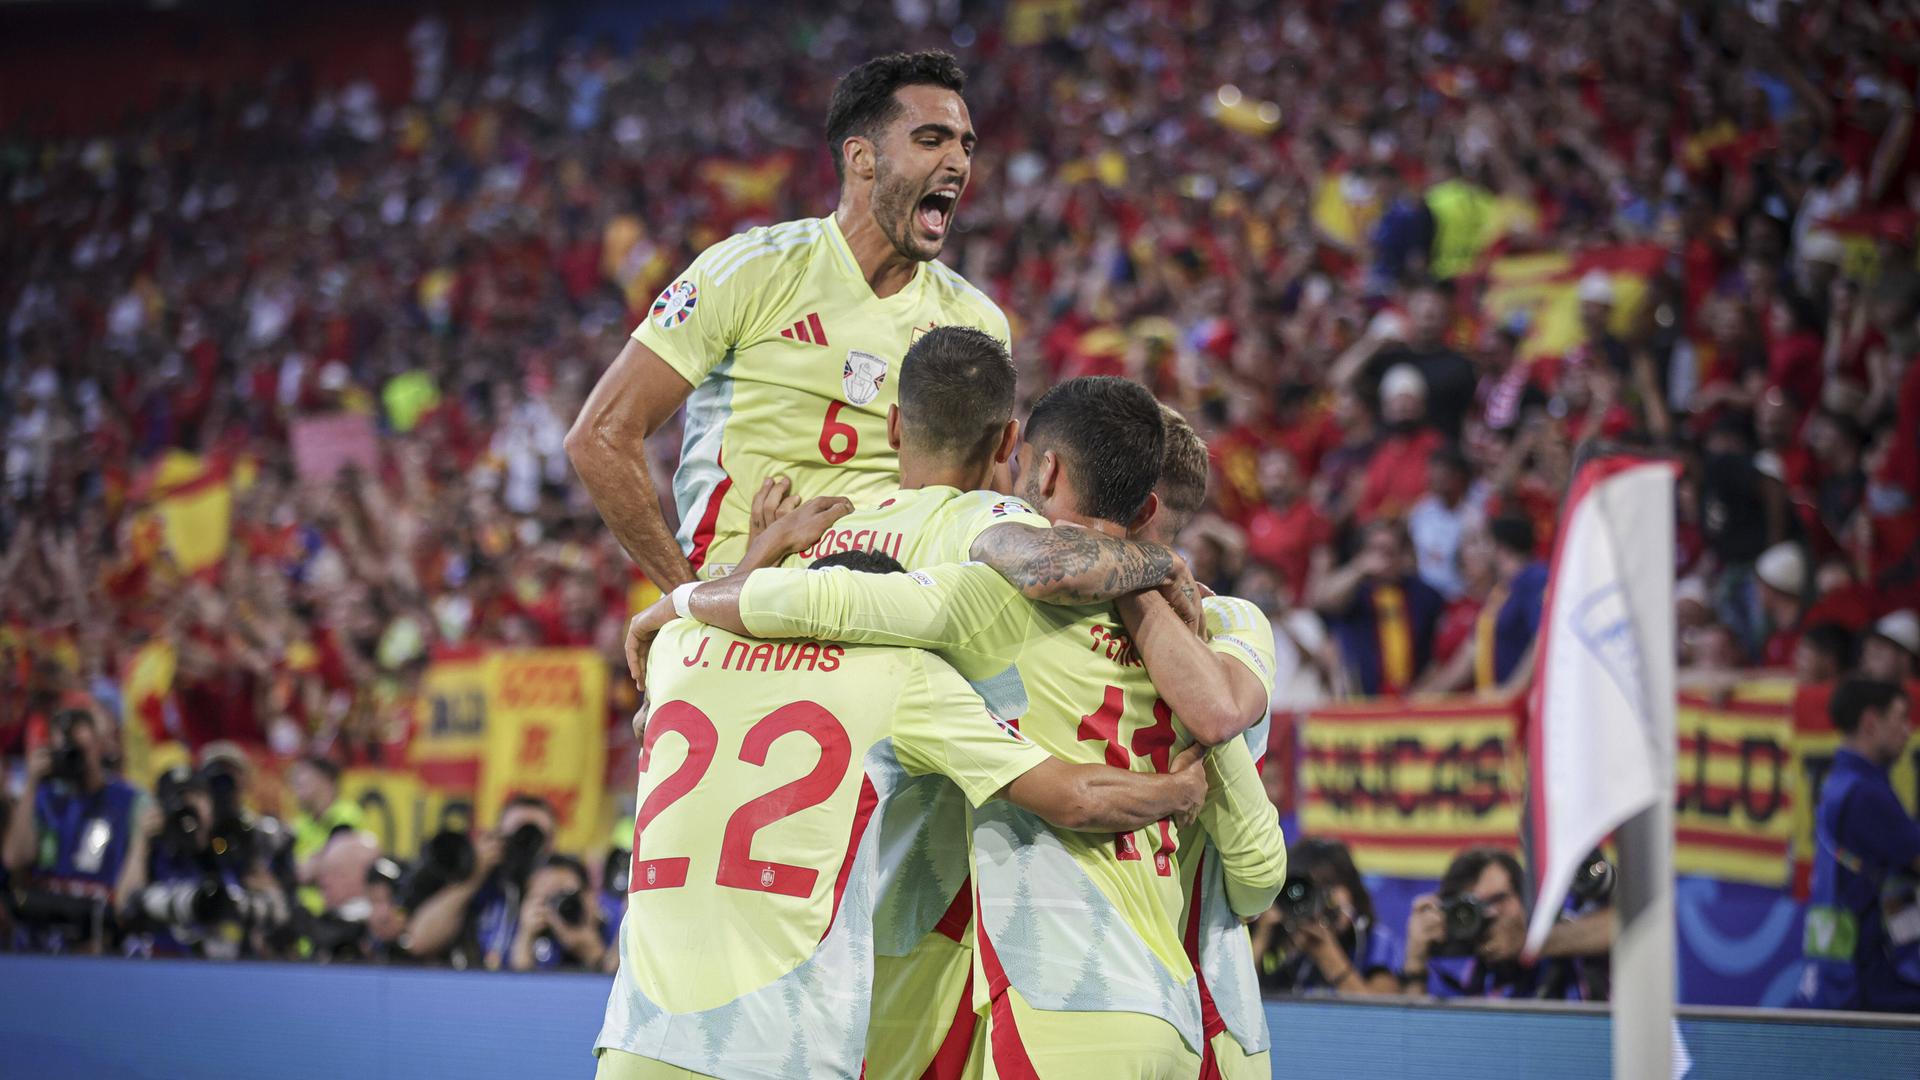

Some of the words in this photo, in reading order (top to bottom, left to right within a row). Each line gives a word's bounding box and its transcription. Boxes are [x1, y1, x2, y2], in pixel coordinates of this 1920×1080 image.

[818, 399, 858, 465] 6
[682, 636, 711, 668] J.
[721, 640, 845, 672] NAVAS
[628, 699, 852, 898] 22
[1077, 684, 1176, 877] 11
